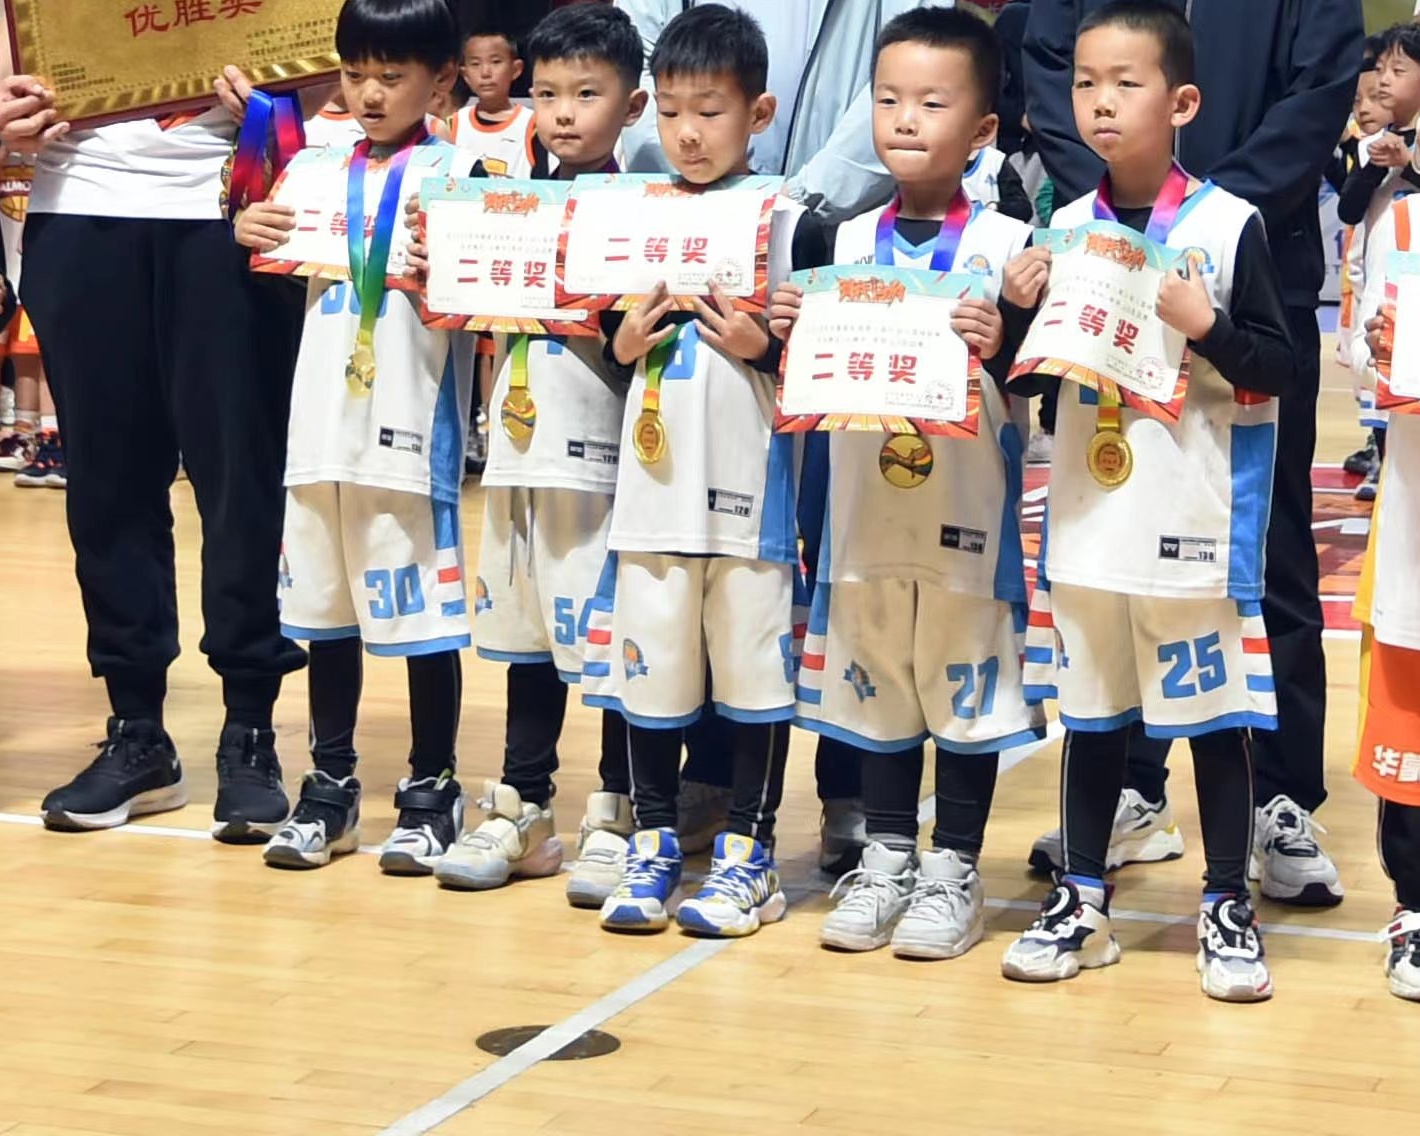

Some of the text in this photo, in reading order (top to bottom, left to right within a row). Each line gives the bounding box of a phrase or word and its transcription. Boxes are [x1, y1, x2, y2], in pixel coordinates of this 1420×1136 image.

[604, 236, 710, 264] 二等奖
[457, 259, 548, 288] 二等奖
[1043, 301, 1140, 355] 二等奖
[811, 351, 918, 384] 二等奖
[364, 563, 425, 620] 30
[1157, 630, 1228, 700] 25
